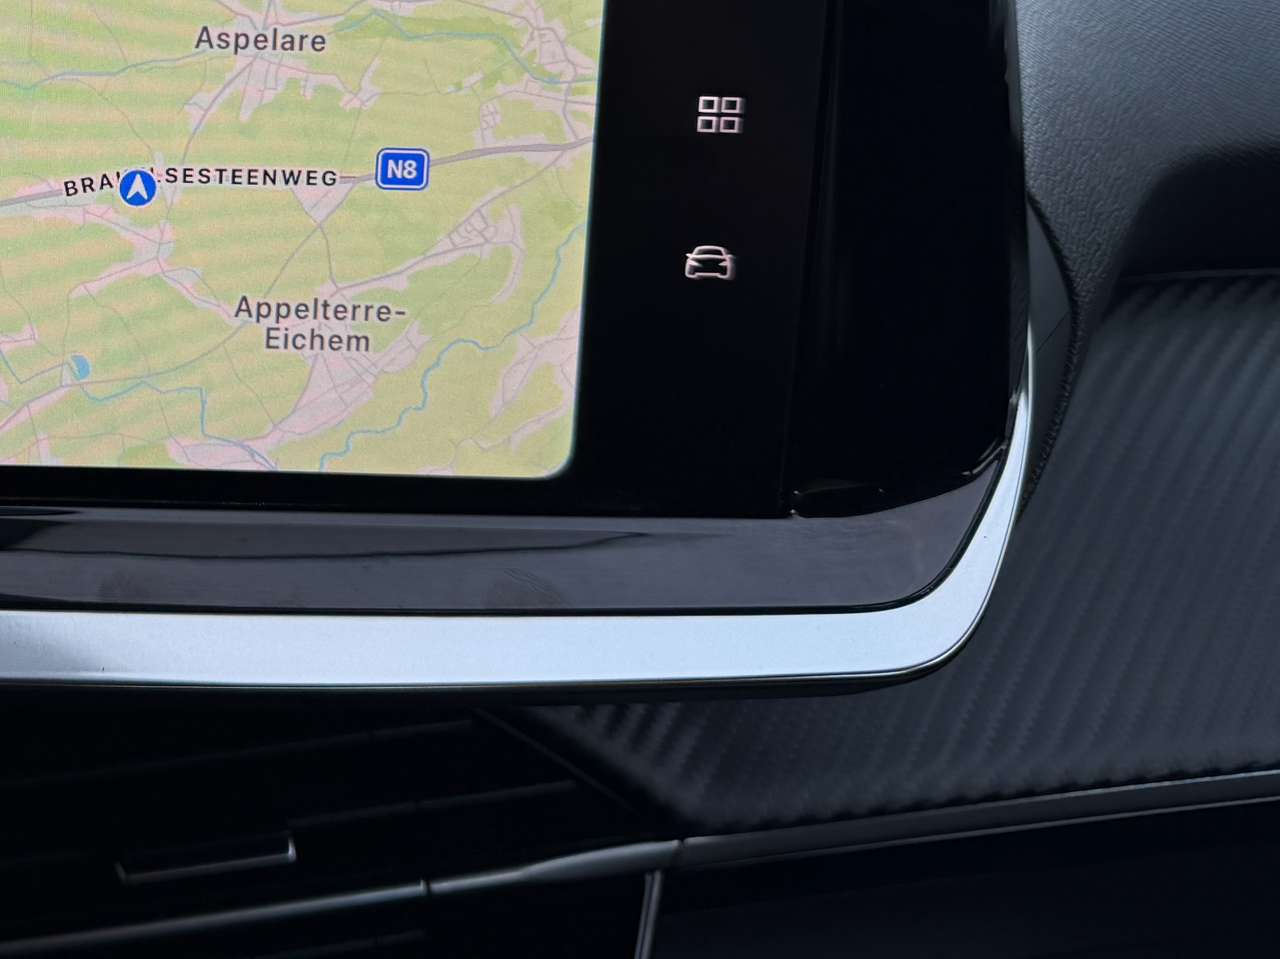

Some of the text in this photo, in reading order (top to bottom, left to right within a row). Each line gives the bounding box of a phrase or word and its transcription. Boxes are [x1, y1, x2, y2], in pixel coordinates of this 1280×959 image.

[194, 25, 327, 56] Aspelare
[64, 167, 337, 197] BRASESTEENWEG
[387, 159, 417, 179] N8
[234, 295, 406, 324] Appelterre-
[265, 327, 370, 352] Eichem
